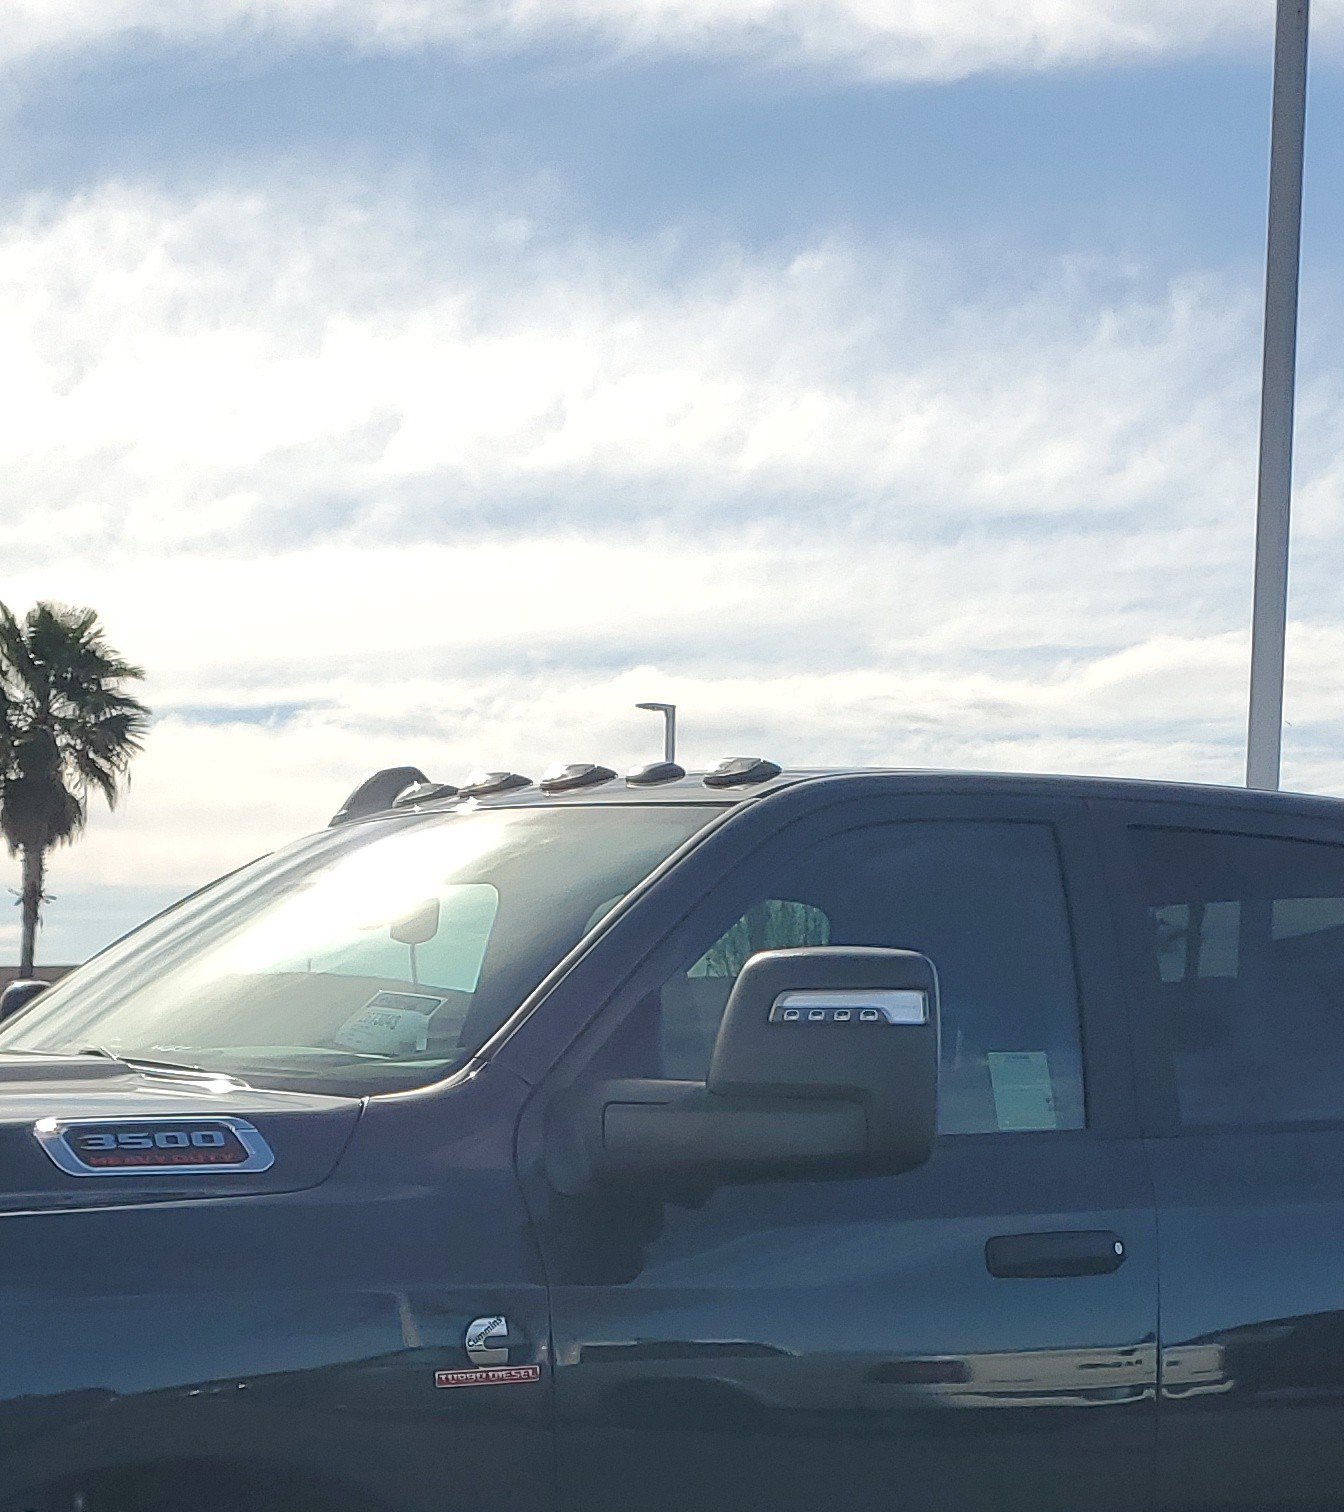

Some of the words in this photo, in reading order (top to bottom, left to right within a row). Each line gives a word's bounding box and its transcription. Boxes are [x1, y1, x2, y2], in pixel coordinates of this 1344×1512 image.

[77, 1131, 226, 1149] 3500
[467, 1316, 504, 1348] Cummins
[439, 1373, 487, 1384] TURBO
[488, 1369, 537, 1380] DIESEL
